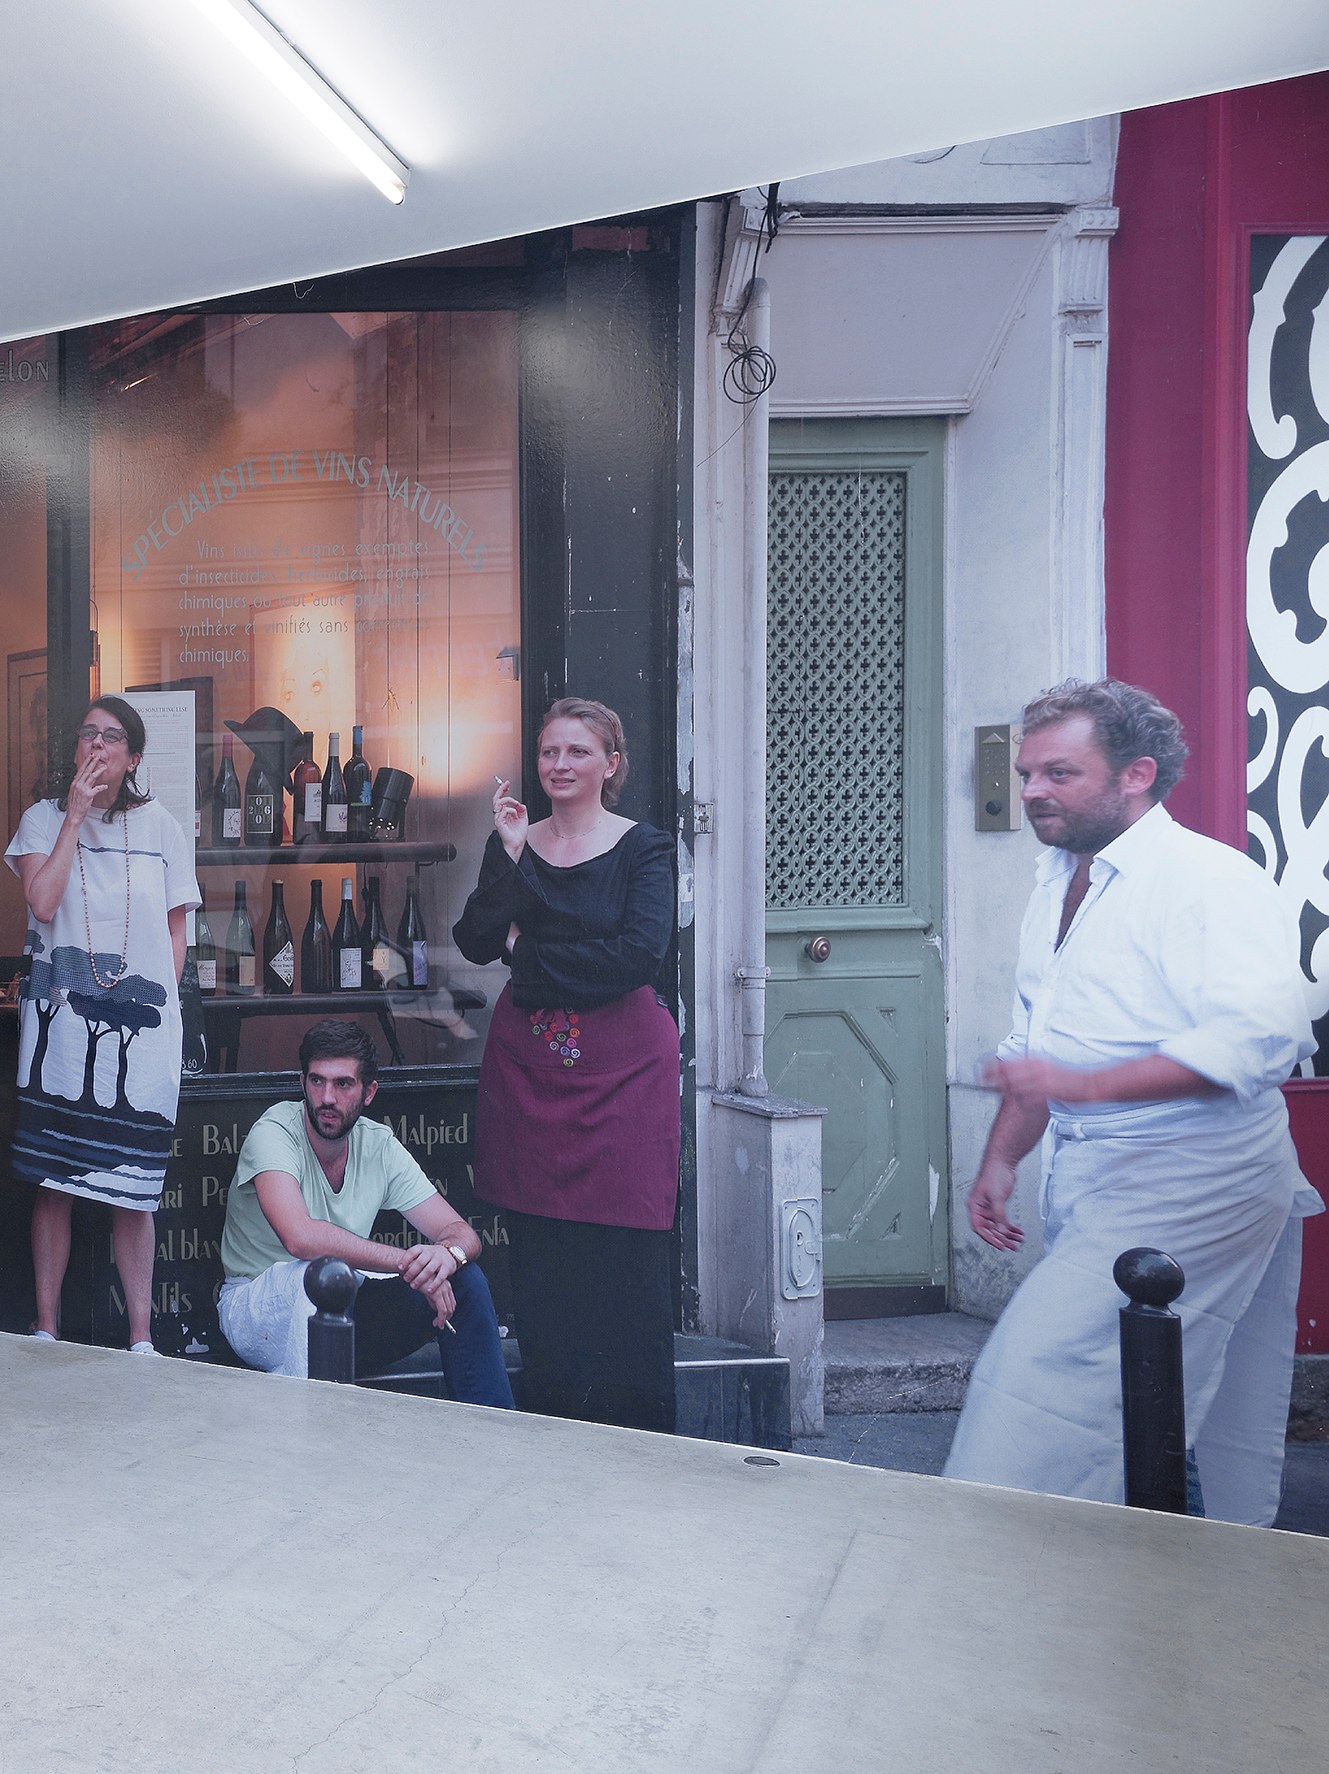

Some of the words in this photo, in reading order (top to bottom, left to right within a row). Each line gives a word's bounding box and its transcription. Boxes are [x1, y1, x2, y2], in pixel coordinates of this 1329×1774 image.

[121, 457, 264, 581] SPÉCIALISTE
[270, 449, 304, 483] DE
[312, 449, 372, 489] VINS
[377, 464, 489, 573] NATURELS
[197, 540, 225, 560] Vins
[299, 543, 346, 565] vignes
[355, 539, 429, 562] exemptes
[377, 566, 430, 588] engrais
[178, 590, 247, 618] chimiques
[253, 596, 272, 609] ou
[313, 594, 347, 607] autre
[179, 616, 237, 643] synthèse
[245, 620, 257, 636] et
[263, 614, 311, 634] vinifiés
[319, 620, 350, 634] sans
